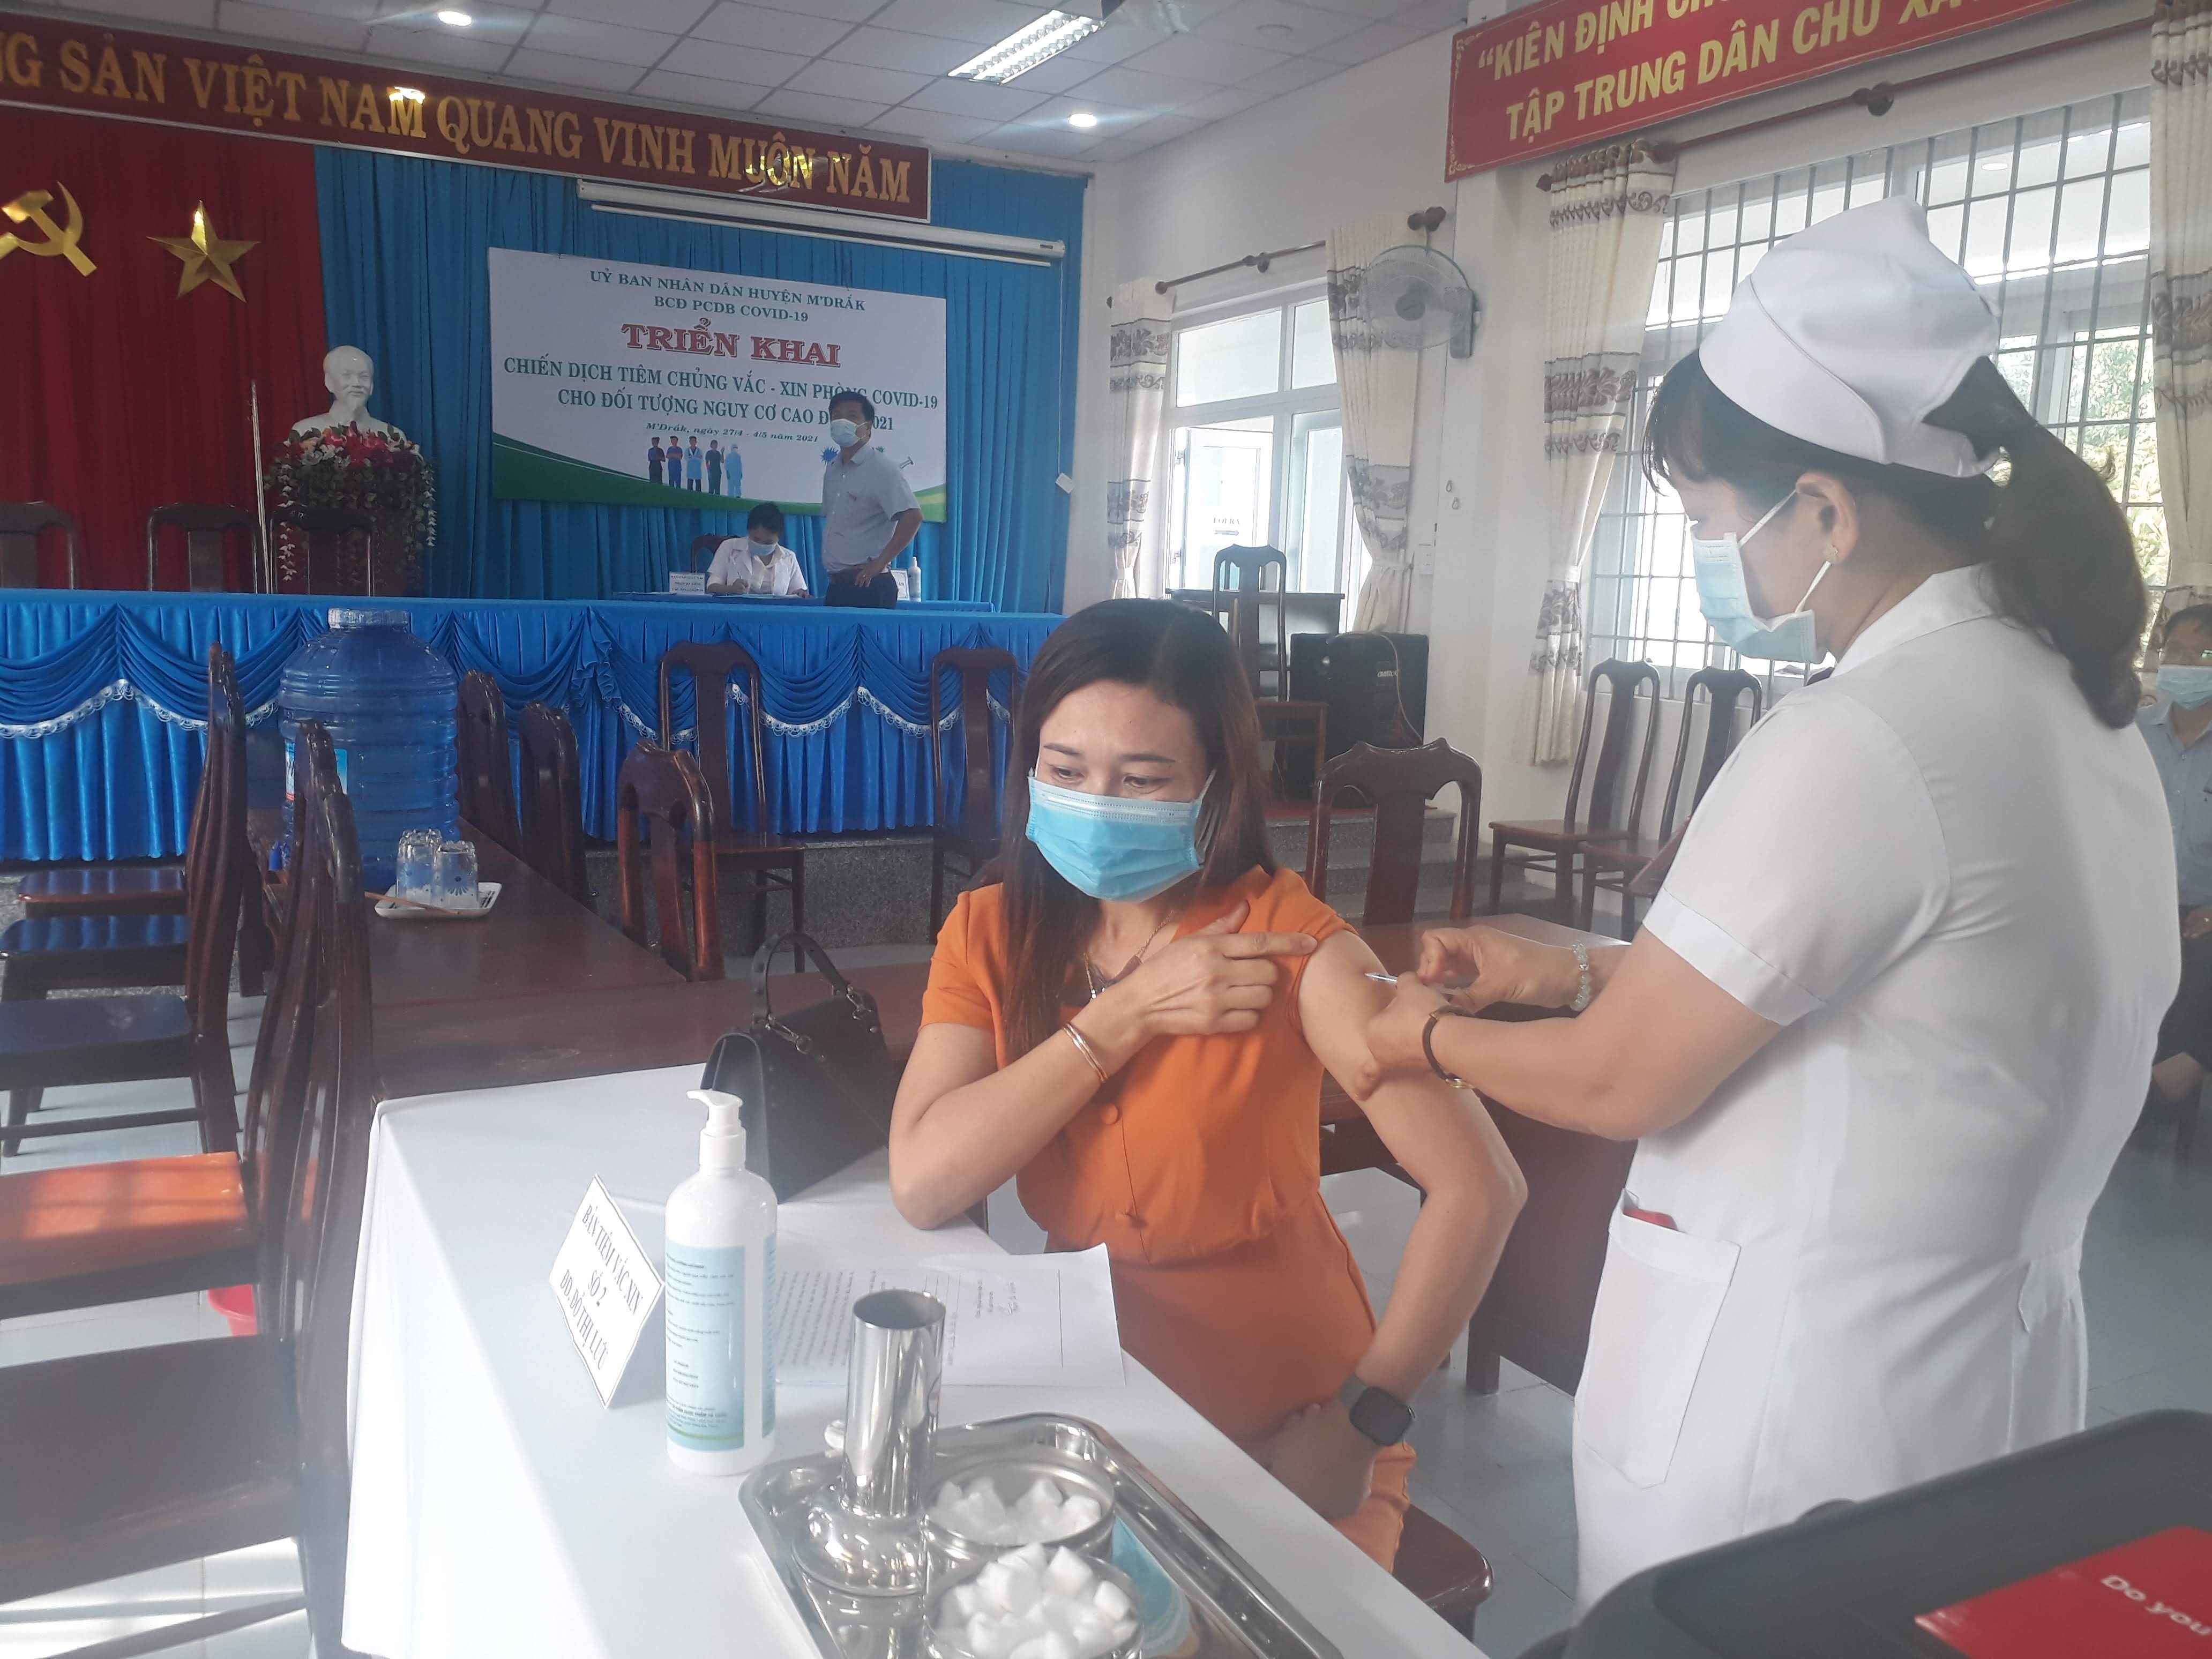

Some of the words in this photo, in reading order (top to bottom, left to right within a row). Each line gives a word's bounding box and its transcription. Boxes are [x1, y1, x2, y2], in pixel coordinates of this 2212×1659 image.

[1506, 87, 1564, 143] TẬP
[1574, 50, 1686, 121] TRUNG
[1698, 18, 1779, 85] DÂN
[60, 34, 167, 103] SẢN
[184, 54, 307, 127] VIỆT
[319, 77, 427, 138] NAM
[437, 96, 583, 159] QUANG
[593, 117, 696, 174] VINH
[708, 131, 816, 189] MUÔN
[826, 143, 910, 203] NĂM
[591, 268, 612, 282] UỶ
[618, 273, 652, 288] BAN
[657, 278, 704, 293] NHÂN
[710, 282, 743, 296] DÂN
[748, 287, 802, 304] HUYỆN
[693, 300, 735, 314] PCDB
[741, 305, 808, 322] COVID-19
[621, 317, 739, 357] TRIỂN
[751, 336, 841, 368] KHAI
[504, 354, 562, 376] CHIẾN
[568, 362, 613, 382] DỊCH
[618, 364, 662, 385] TIÊM
[668, 367, 728, 391] CHỦNG
[733, 370, 766, 394] VẮC
[780, 381, 808, 397] XIN
[872, 390, 938, 409] COVID-19
[558, 389, 595, 406] CHO
[602, 386, 632, 409] ĐỐI
[638, 393, 698, 415] TƯỢNG
[703, 400, 749, 418] NGUY
[754, 404, 776, 421] CƠ
[781, 407, 813, 424] CAO
[596, 1287, 607, 1307] 2
[623, 1279, 643, 1315] XIN
[2100, 1574, 2147, 1602] Do
